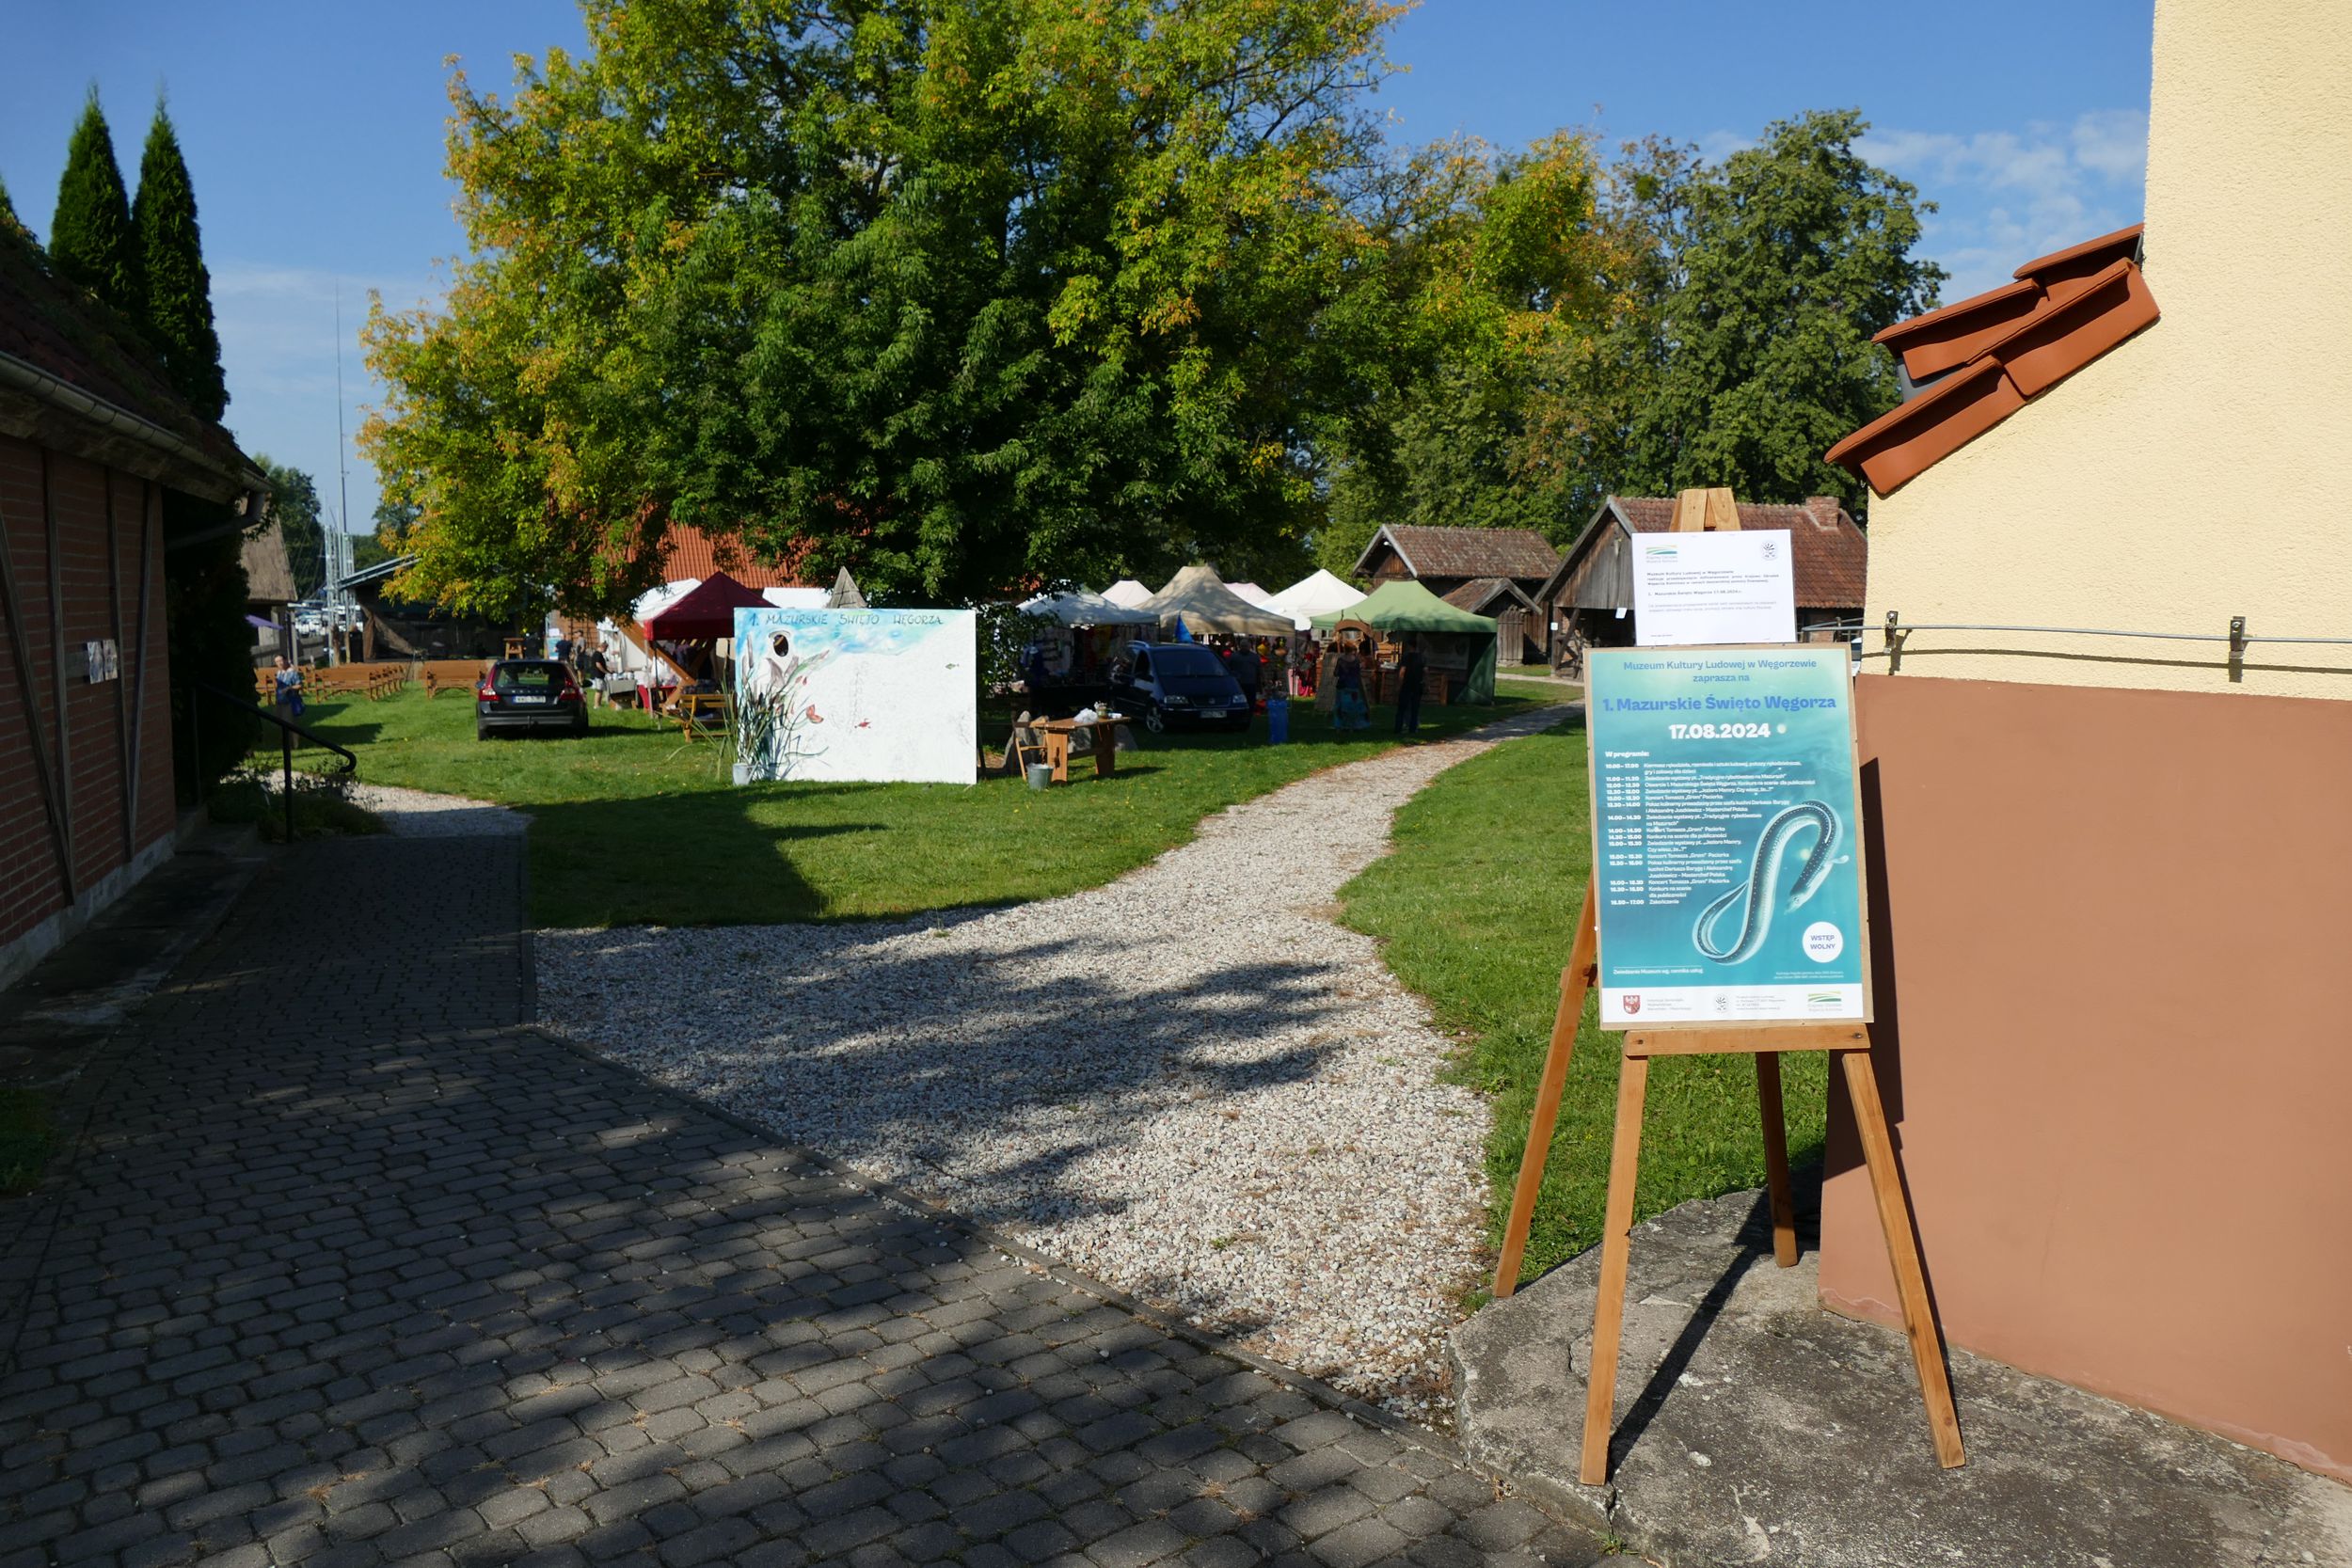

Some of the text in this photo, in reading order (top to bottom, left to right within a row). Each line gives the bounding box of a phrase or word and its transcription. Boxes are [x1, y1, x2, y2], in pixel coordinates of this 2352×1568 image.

[1623, 660, 1664, 671] Muzeum
[1667, 660, 1703, 671] Kultury
[1705, 659, 1745, 671] Ludowej
[1757, 658, 1817, 669] Węgorzewie
[1693, 674, 1736, 684] zaprasza
[1603, 694, 1836, 712] 1. Mazurskie Święto Węgorza
[1668, 723, 1771, 739] 17.08.2024
